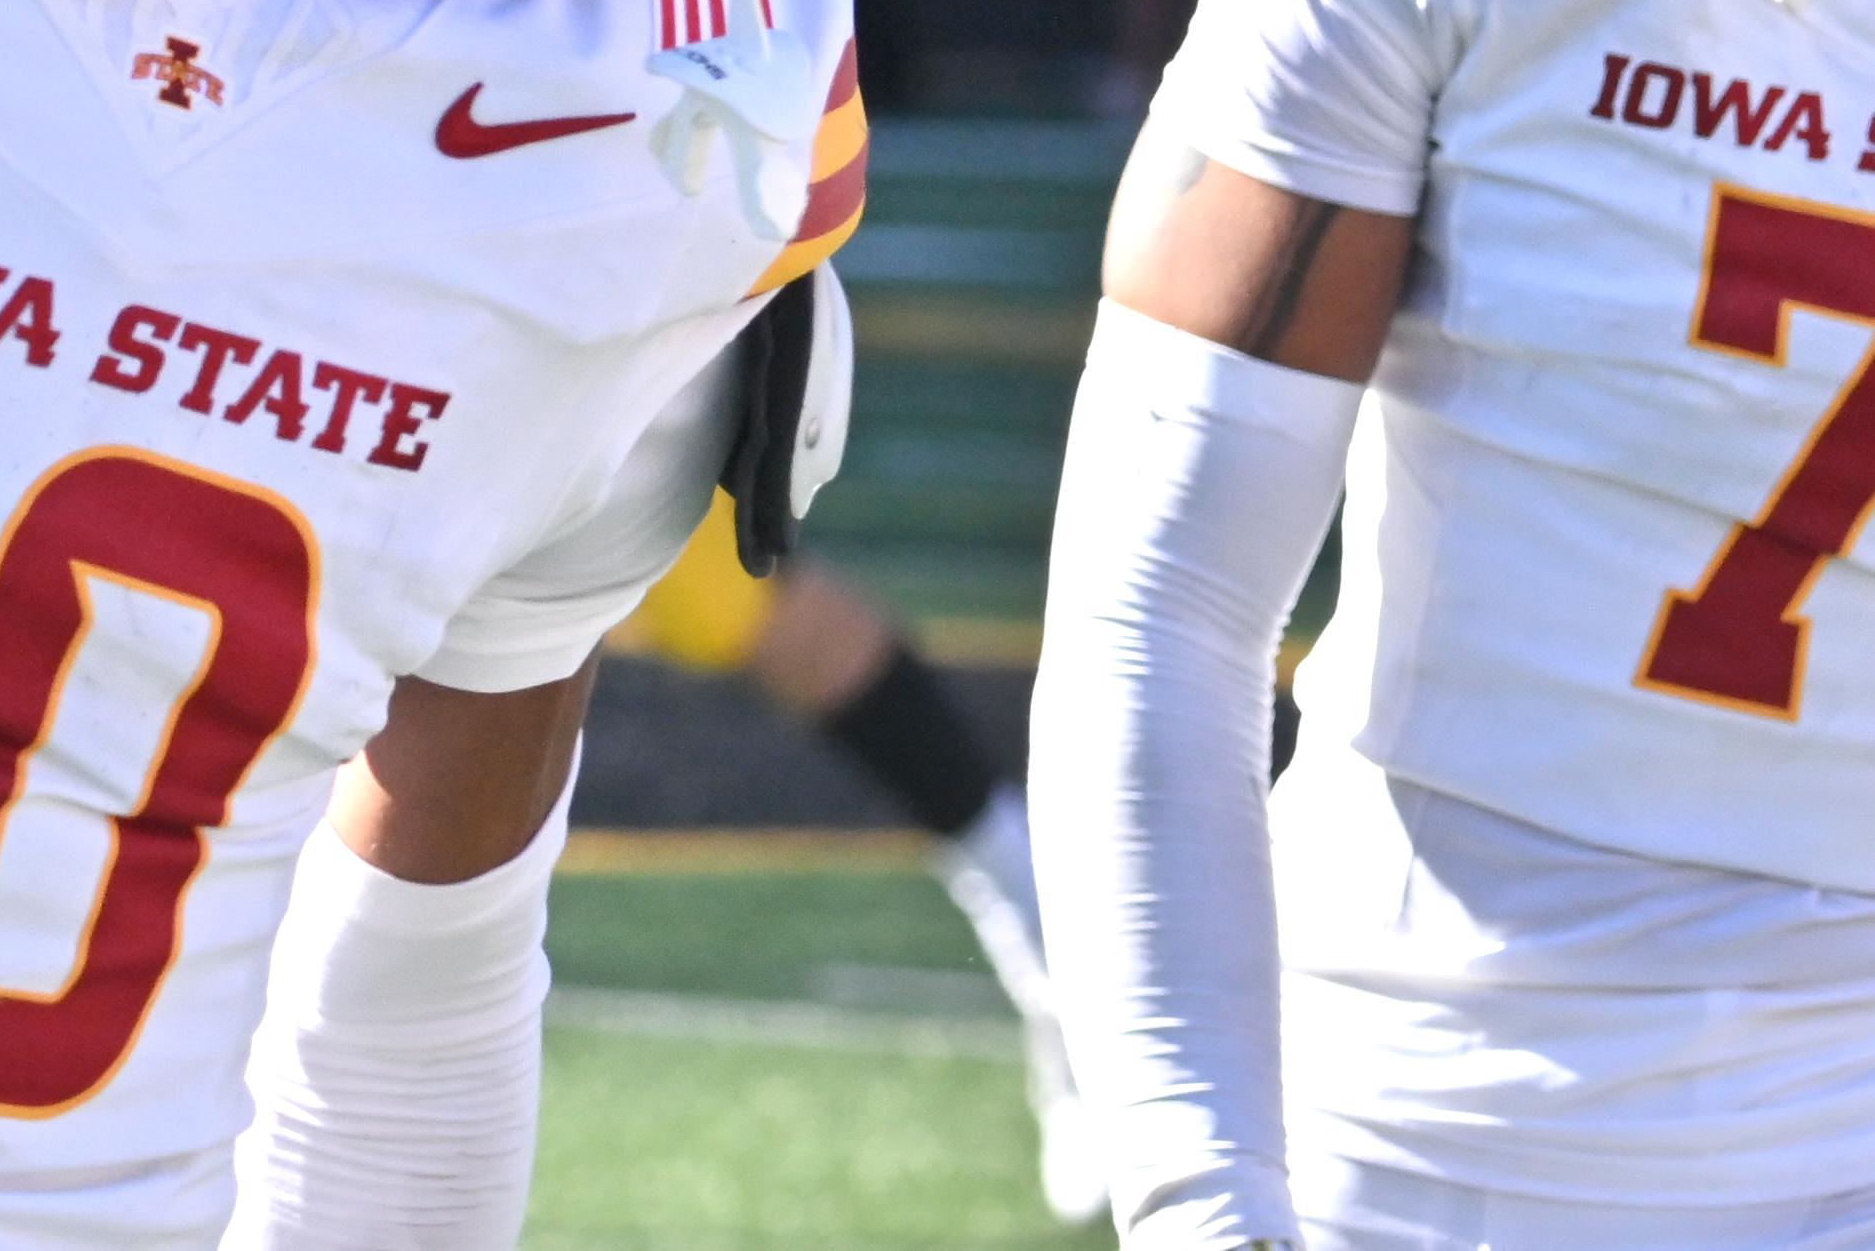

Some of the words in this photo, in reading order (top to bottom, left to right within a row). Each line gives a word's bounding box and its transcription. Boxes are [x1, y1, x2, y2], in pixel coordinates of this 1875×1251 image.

[1590, 53, 1831, 161] IOWA
[90, 304, 452, 473] STATE
[1632, 180, 1875, 723] 7
